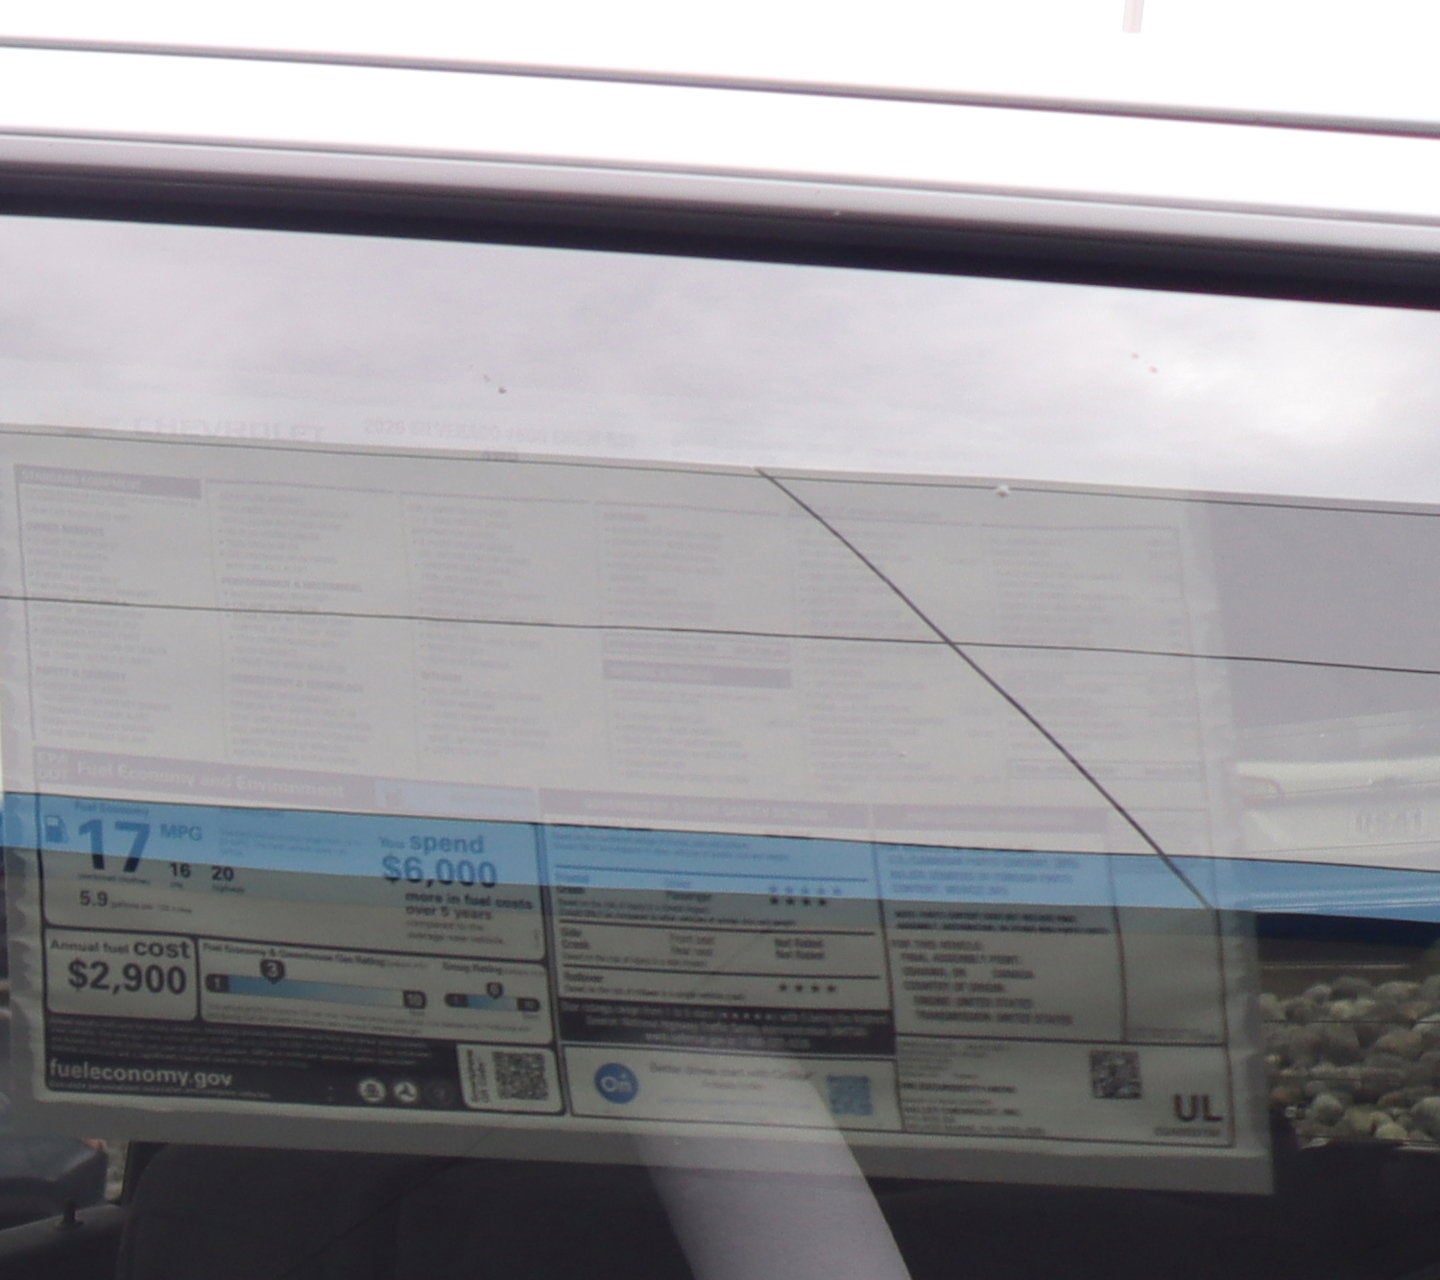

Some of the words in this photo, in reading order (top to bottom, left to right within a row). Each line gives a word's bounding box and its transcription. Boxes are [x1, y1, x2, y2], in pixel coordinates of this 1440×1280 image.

[78, 818, 150, 873] 17
[160, 823, 203, 841] MPG
[409, 833, 485, 856] spend
[169, 862, 192, 878] 16
[211, 865, 235, 882] 20
[382, 853, 497, 889] $6,000
[79, 890, 108, 907] 5.9
[132, 940, 191, 959] cost
[67, 957, 188, 996] $2,900
[49, 1060, 233, 1088] fueleconomy.gov
[1172, 1093, 1225, 1123] UL
